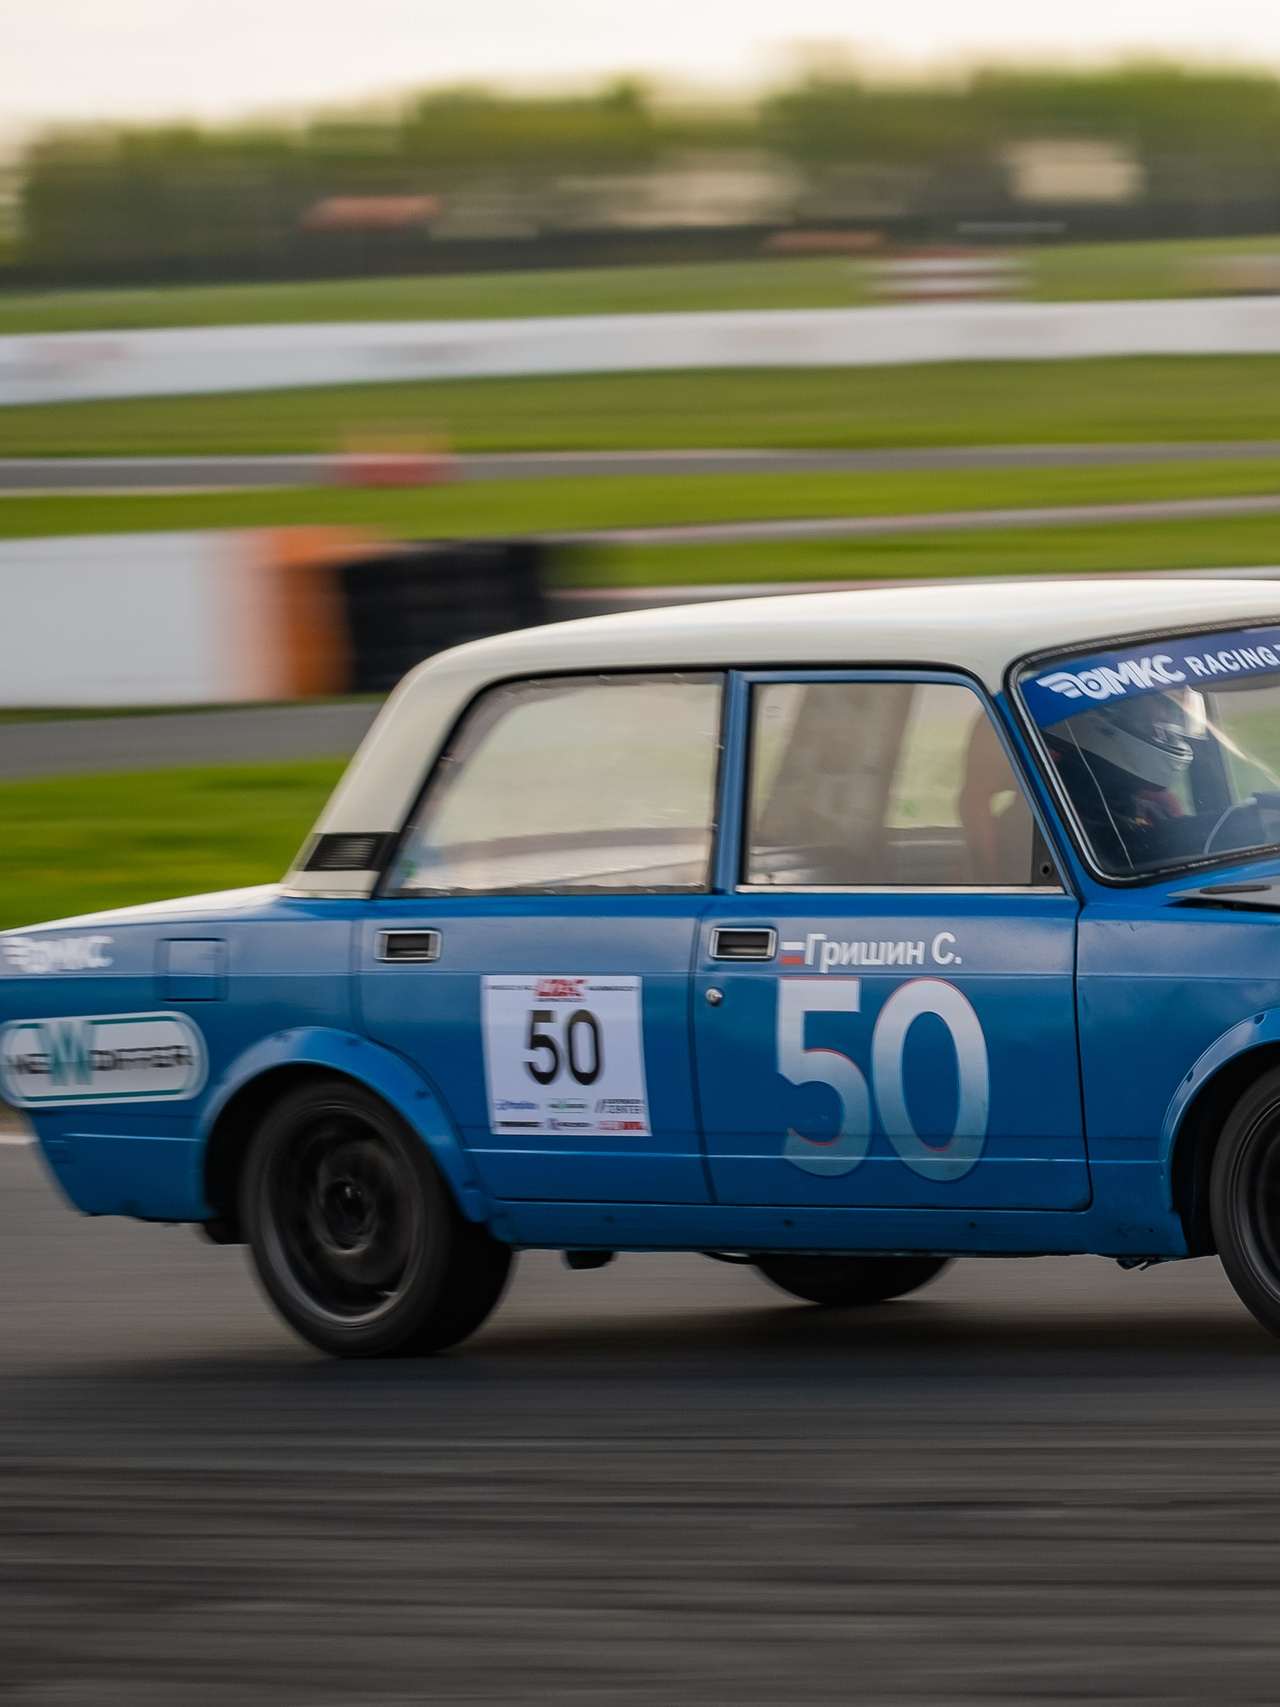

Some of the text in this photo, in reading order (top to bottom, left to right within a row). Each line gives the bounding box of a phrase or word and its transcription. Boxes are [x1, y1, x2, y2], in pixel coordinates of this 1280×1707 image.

[805, 932, 926, 973] Гришин
[524, 1009, 606, 1086] 50
[777, 976, 990, 1182] 50
